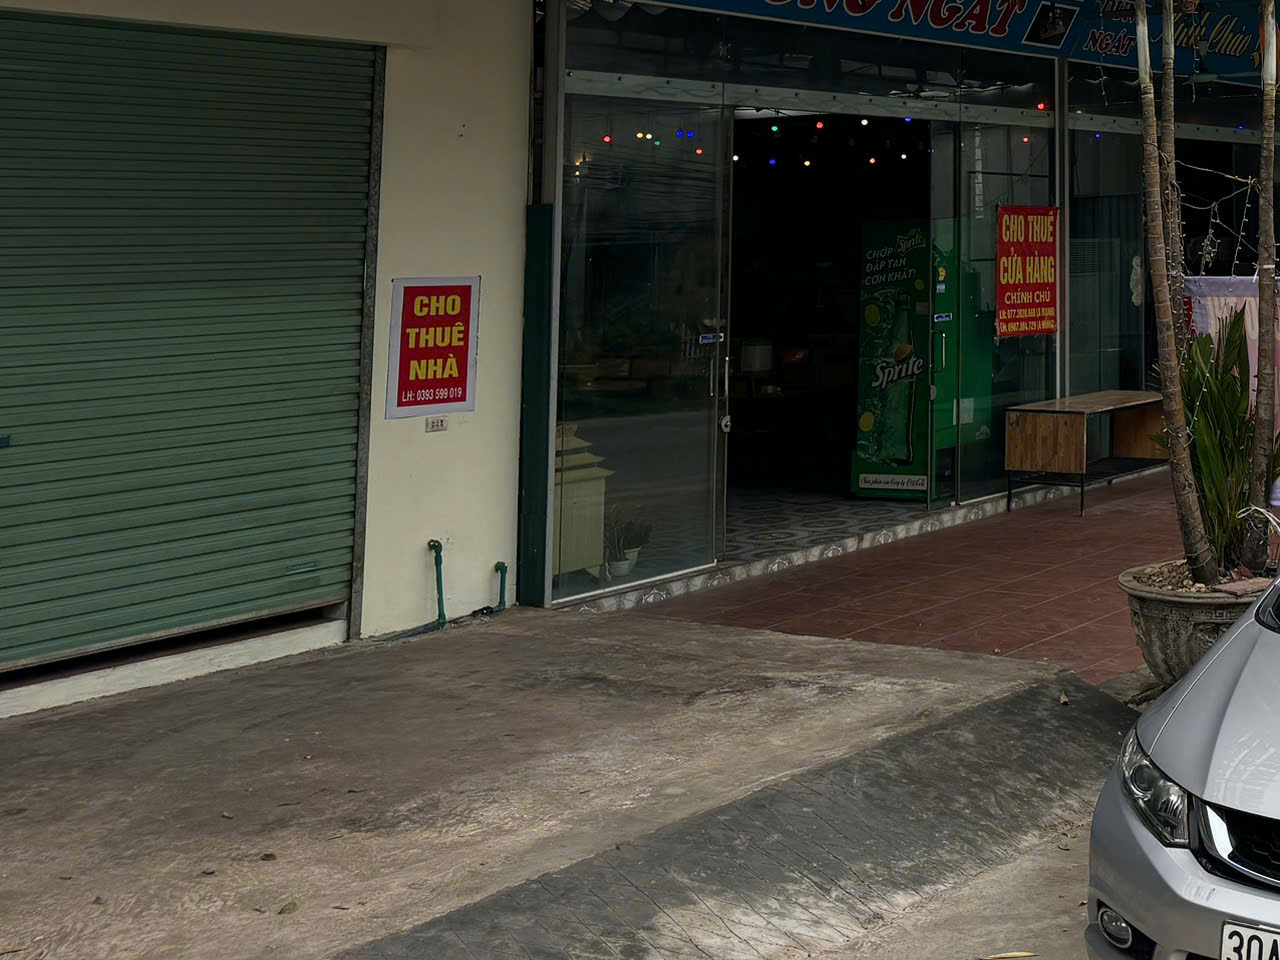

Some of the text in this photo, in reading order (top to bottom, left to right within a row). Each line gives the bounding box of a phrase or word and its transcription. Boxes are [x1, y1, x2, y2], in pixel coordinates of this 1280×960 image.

[1002, 210, 1054, 243] CHO THUÊ
[1000, 247, 1055, 285] CỬA HÀNG
[413, 294, 462, 317] CHO
[1004, 288, 1033, 305] CHÍNH
[406, 321, 465, 348] THUÊ
[408, 353, 459, 381] NHÀ
[872, 355, 924, 390] Sprite
[401, 387, 463, 402] LH: 0393 599 019
